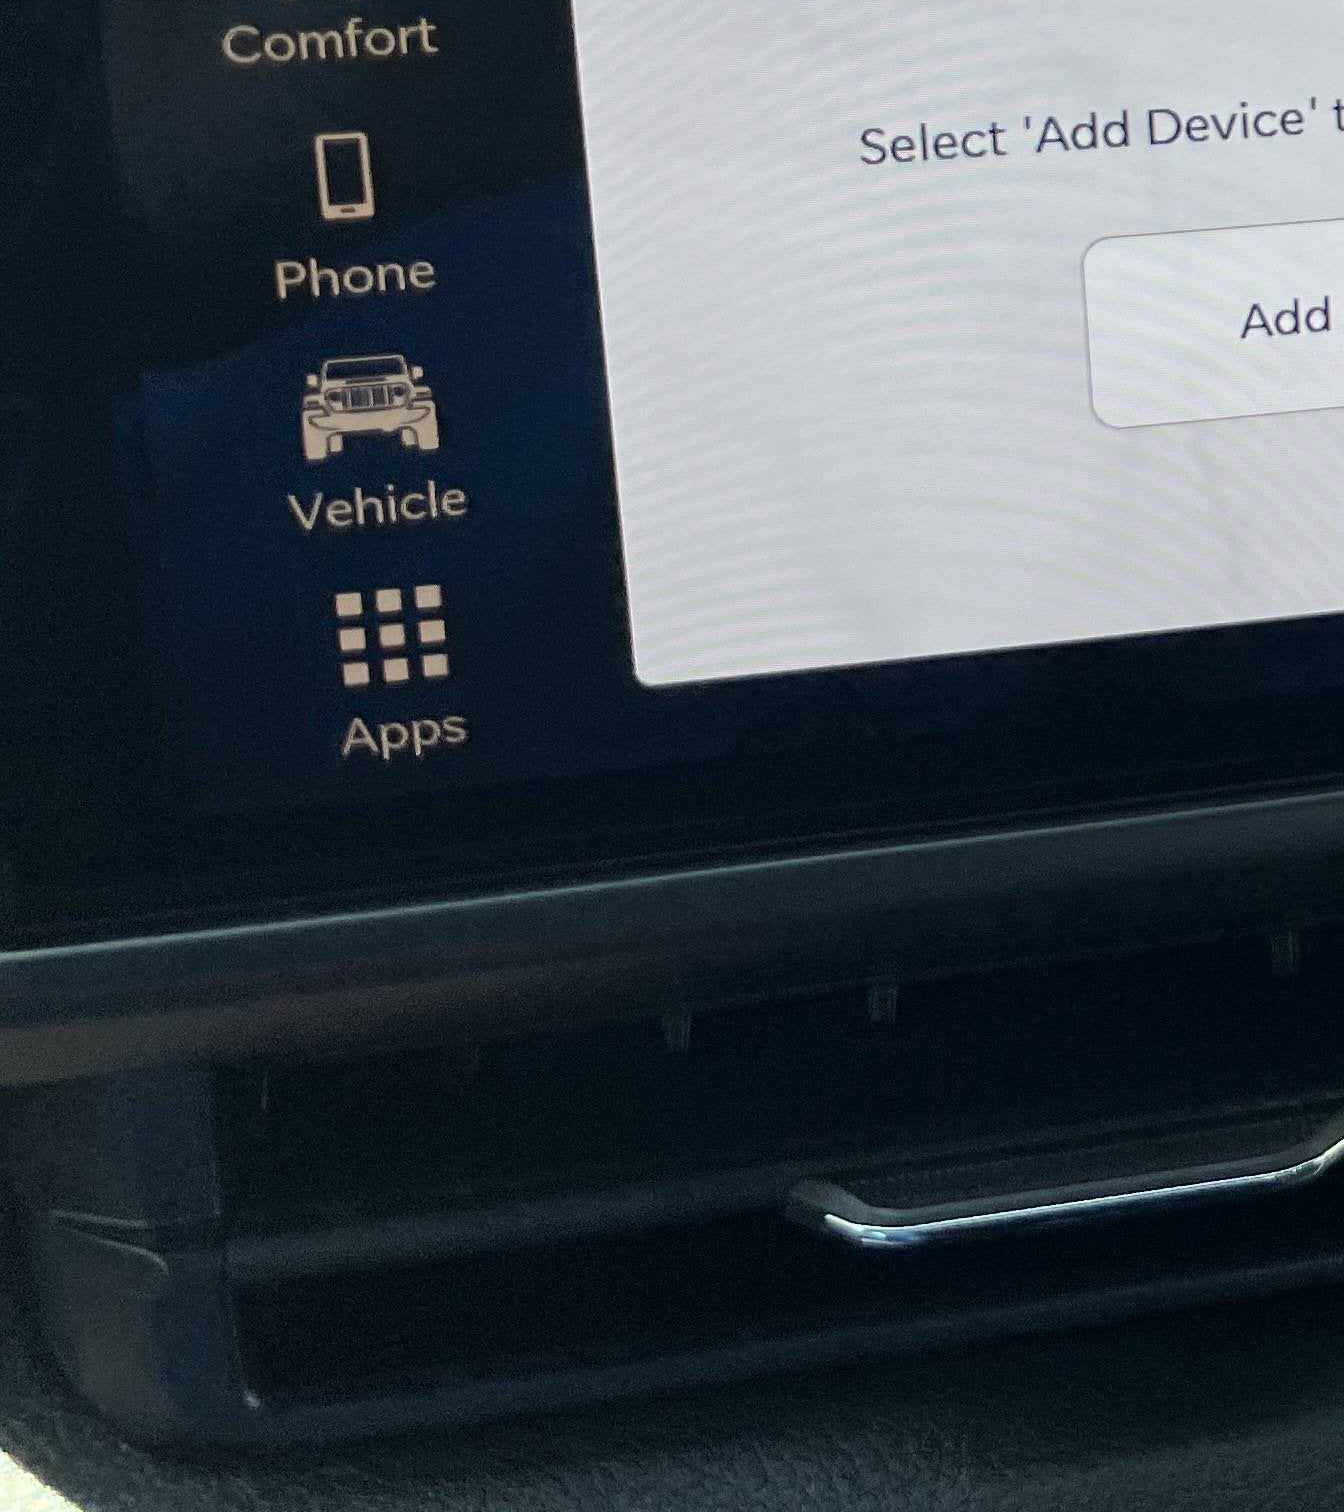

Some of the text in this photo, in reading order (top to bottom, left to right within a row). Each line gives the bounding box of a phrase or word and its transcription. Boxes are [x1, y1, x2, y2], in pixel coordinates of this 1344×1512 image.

[221, 15, 440, 65] Comfort
[859, 120, 1008, 166] Select
[275, 256, 437, 300] Phone
[1239, 294, 1332, 340] Add
[286, 478, 468, 531] Vehicle
[341, 715, 467, 762] Apps
